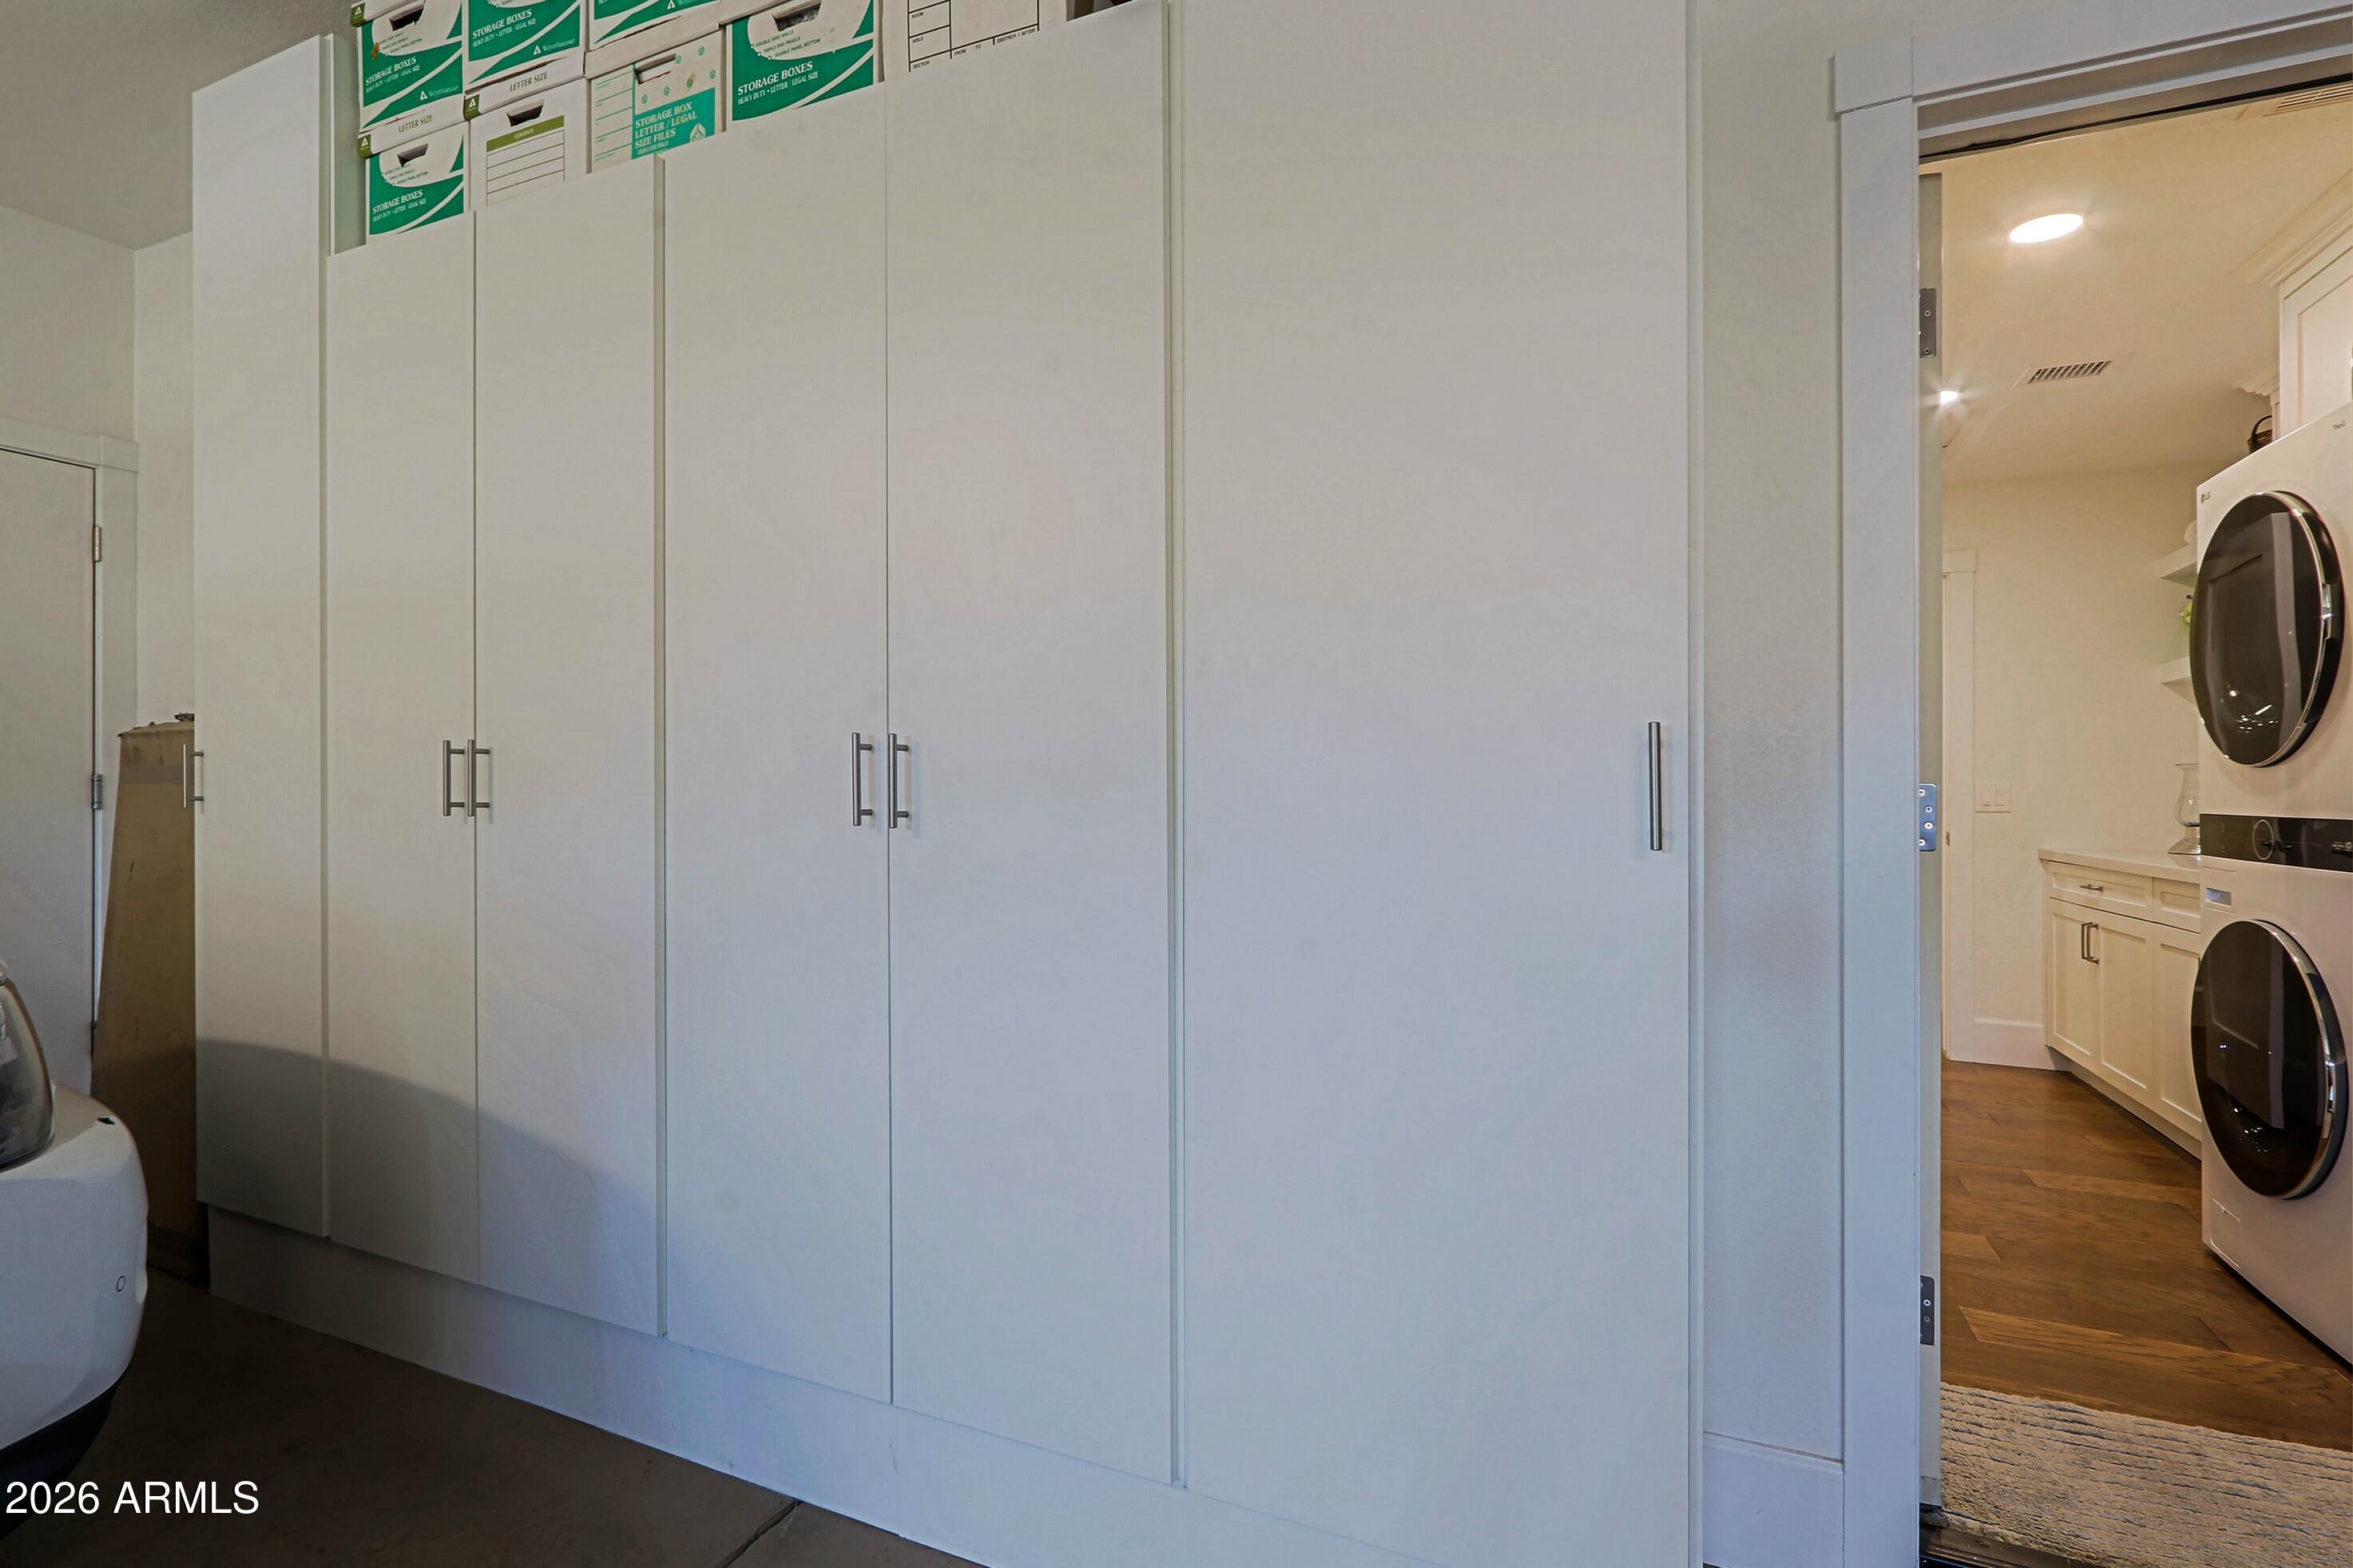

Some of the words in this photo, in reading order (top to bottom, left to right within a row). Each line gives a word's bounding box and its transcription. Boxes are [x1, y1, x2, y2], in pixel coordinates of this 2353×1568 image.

[473, 19, 505, 39] STORAGE
[506, 9, 532, 25] BOXES
[498, 27, 512, 37] LETTER
[997, 34, 1017, 44] DESTROY
[366, 65, 392, 85] STORAGE
[394, 57, 416, 72] BOXES
[913, 61, 930, 69] SECTION
[510, 77, 532, 92] LETTER
[534, 71, 548, 84] SIZE
[738, 73, 779, 96] STORAGE
[781, 62, 813, 80] BOXES
[738, 94, 752, 105] HEAVY
[753, 89, 766, 100] DUTY
[771, 82, 788, 93] LETTER
[792, 76, 807, 86] LEGAL
[808, 71, 819, 81] SIZE
[399, 119, 419, 133] LETTER
[420, 114, 433, 125] SIZE
[635, 109, 673, 129] STORAGE
[674, 102, 692, 115] BOX
[635, 122, 665, 139] LETTER
[671, 111, 697, 126] LEGAL
[635, 137, 653, 149] SIZE
[653, 129, 677, 142] FILES
[373, 197, 400, 215] STORAGE
[401, 189, 423, 204] BOXES
